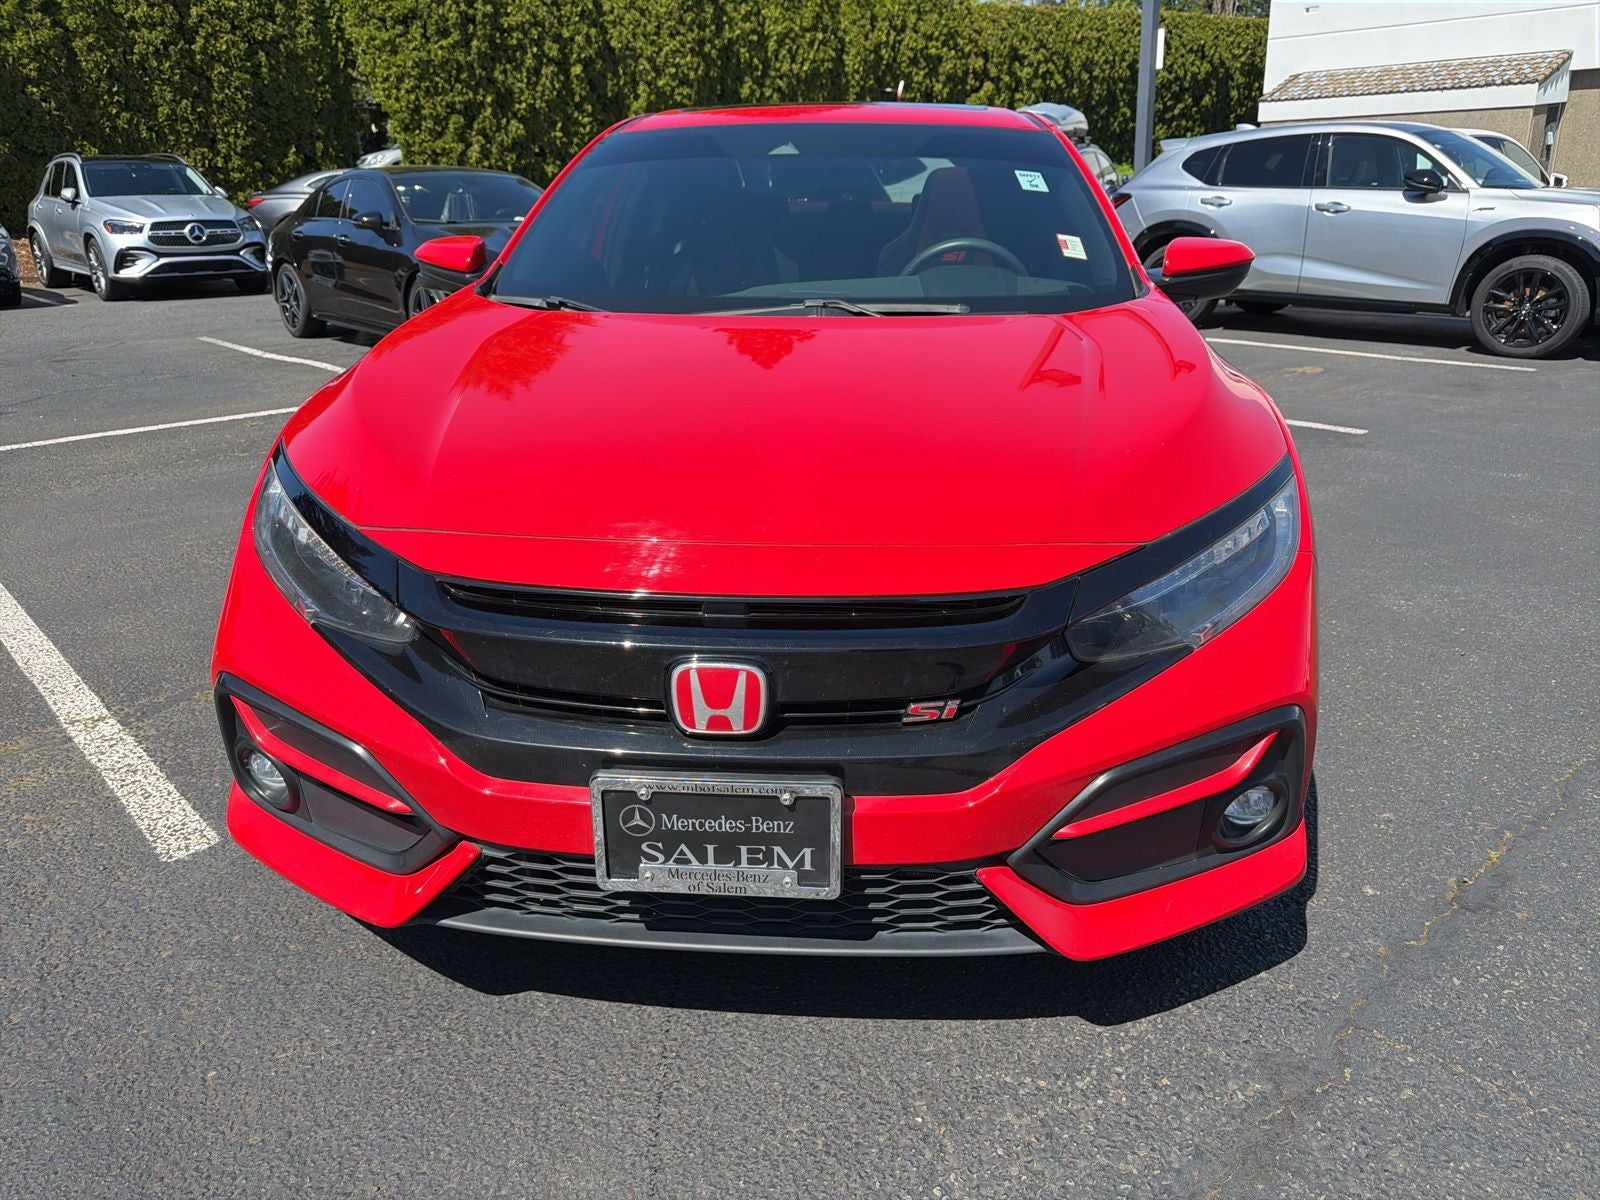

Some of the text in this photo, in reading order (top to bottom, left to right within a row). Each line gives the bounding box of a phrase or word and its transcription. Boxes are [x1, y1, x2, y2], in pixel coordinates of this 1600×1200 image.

[901, 699, 961, 725] Si
[643, 783, 788, 795] www.mbofsalem.com
[660, 813, 794, 834] Mercedes-Benz
[640, 841, 816, 871] SALEM
[667, 867, 769, 884] Mercedes-Benz
[688, 882, 747, 895] of Salem
